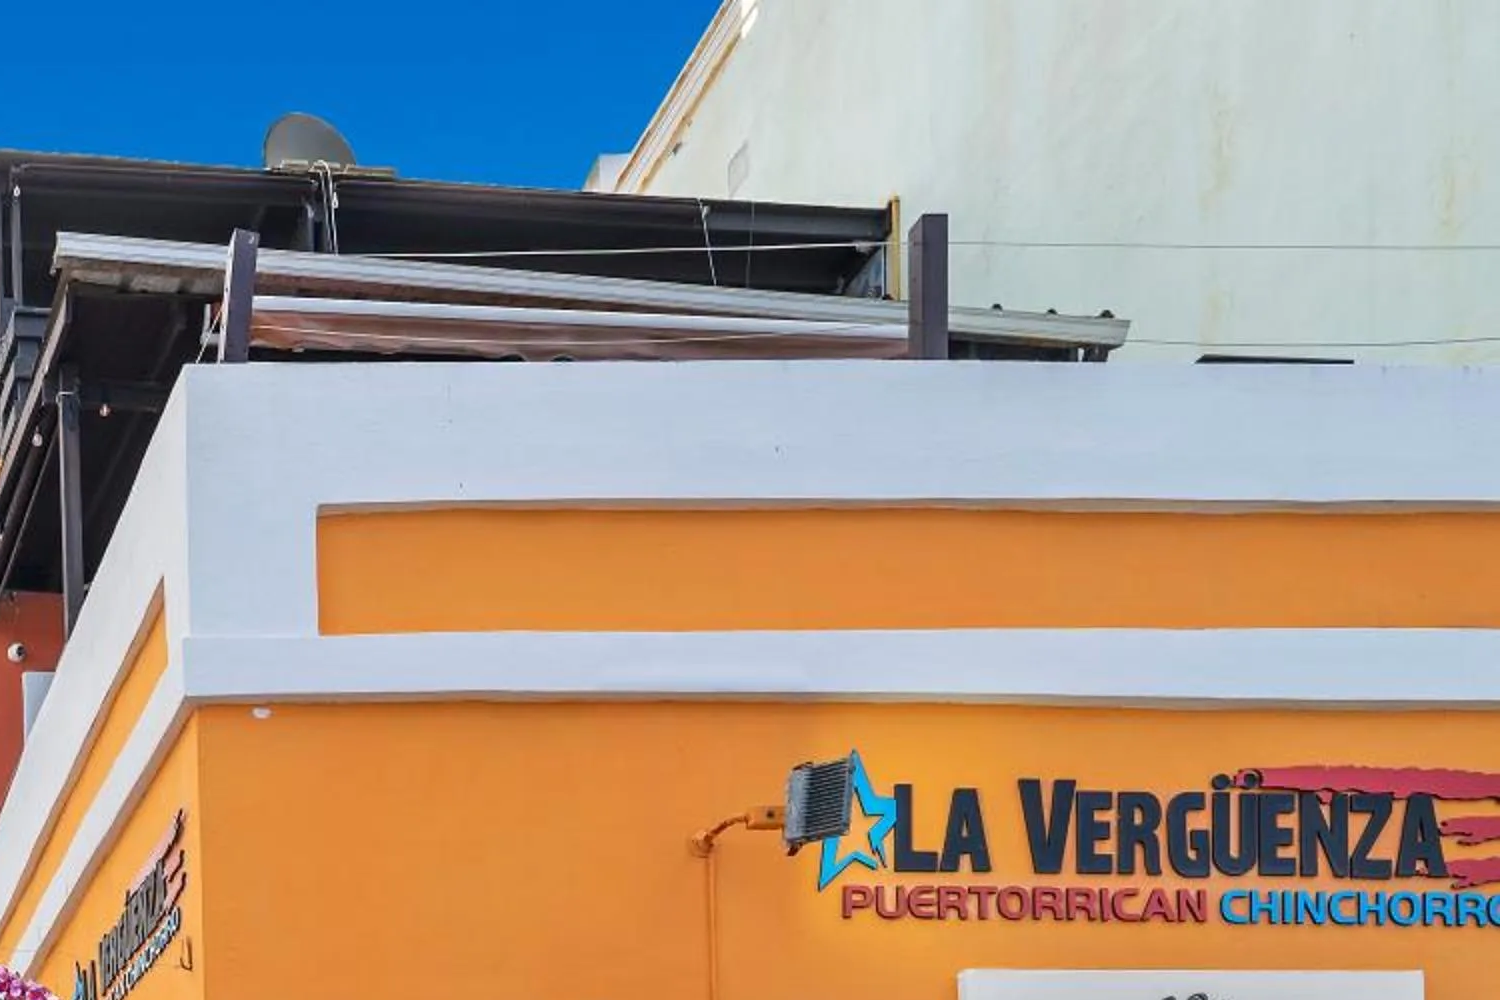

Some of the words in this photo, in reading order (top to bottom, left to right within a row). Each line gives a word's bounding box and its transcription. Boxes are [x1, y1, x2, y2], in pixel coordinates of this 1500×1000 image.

[893, 783, 992, 874] LA
[1017, 773, 1449, 880] VERGÜENZA
[841, 885, 1208, 922] PUERTORRICAN
